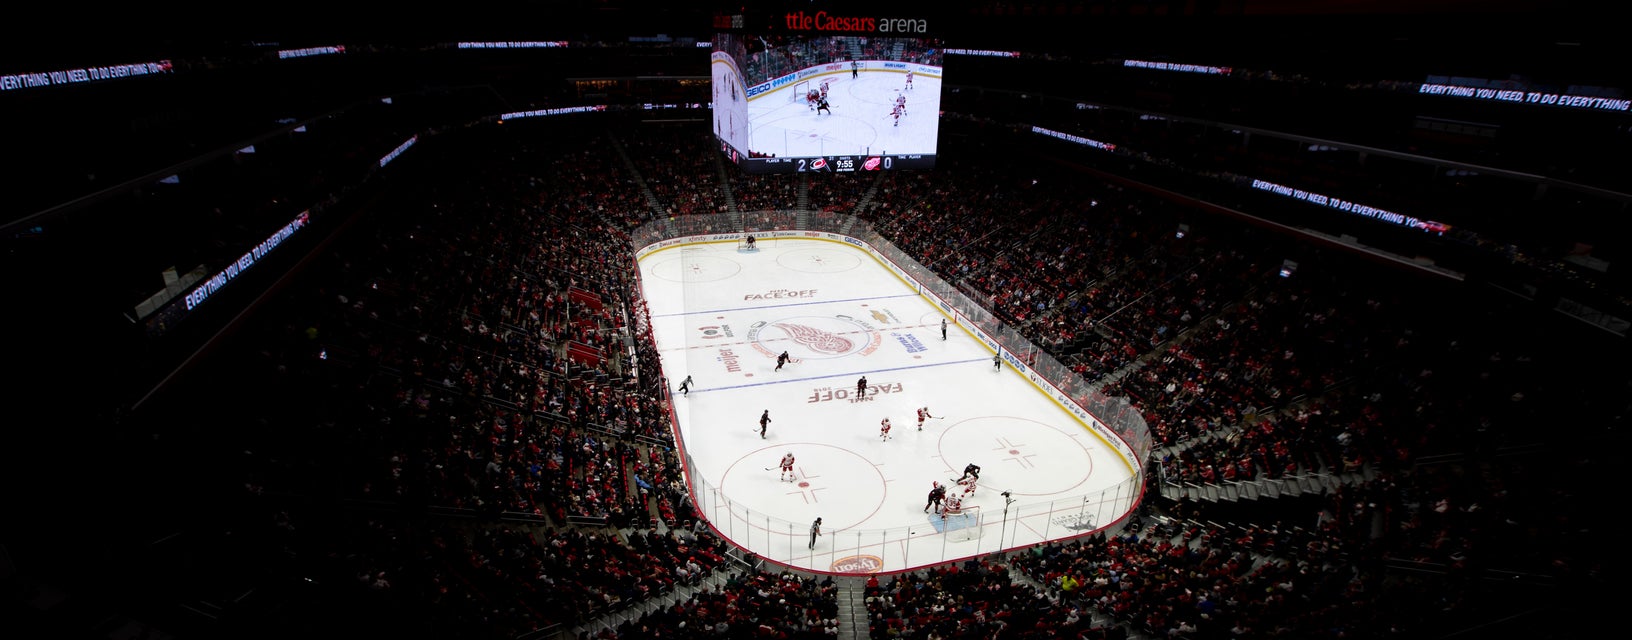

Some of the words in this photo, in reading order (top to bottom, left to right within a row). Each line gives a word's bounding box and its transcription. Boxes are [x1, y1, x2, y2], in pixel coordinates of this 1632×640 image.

[785, 11, 812, 30] ttle
[814, 11, 876, 32] Caesars
[879, 18, 927, 33] arena
[0, 72, 50, 90] VERYTHING
[48, 70, 68, 85] YOU
[88, 66, 101, 80] TO
[98, 66, 111, 80] DO
[109, 62, 149, 79] EVERYTHING
[746, 83, 771, 98] GEICO
[1419, 84, 1475, 97] EVERYTHING
[1475, 88, 1496, 99] YOU
[1495, 89, 1525, 103] NEED,
[1526, 92, 1541, 103] TO
[1540, 93, 1559, 105] DO
[1557, 95, 1631, 111] EVERYTHING
[798, 159, 806, 172] 2
[836, 160, 853, 168] 9:55
[884, 157, 892, 169] 0
[1252, 179, 1293, 196] EVERYTHING
[1293, 189, 1308, 200] YOU
[1307, 193, 1329, 206] NEED,
[1328, 198, 1341, 208] TO
[1339, 201, 1352, 211] DO
[1351, 203, 1404, 224] EVERYTHING
[844, 236, 863, 247] GEICO
[185, 271, 227, 311] EVERYTHING
[225, 262, 239, 281] YOU
[252, 245, 260, 261] TO
[259, 242, 268, 256] DO
[266, 223, 294, 251] EVERYTHING
[744, 289, 818, 301] FACE-OFF
[717, 349, 742, 373] meijer
[807, 383, 904, 403] FAC-OFF
[834, 558, 877, 572] Tyson
